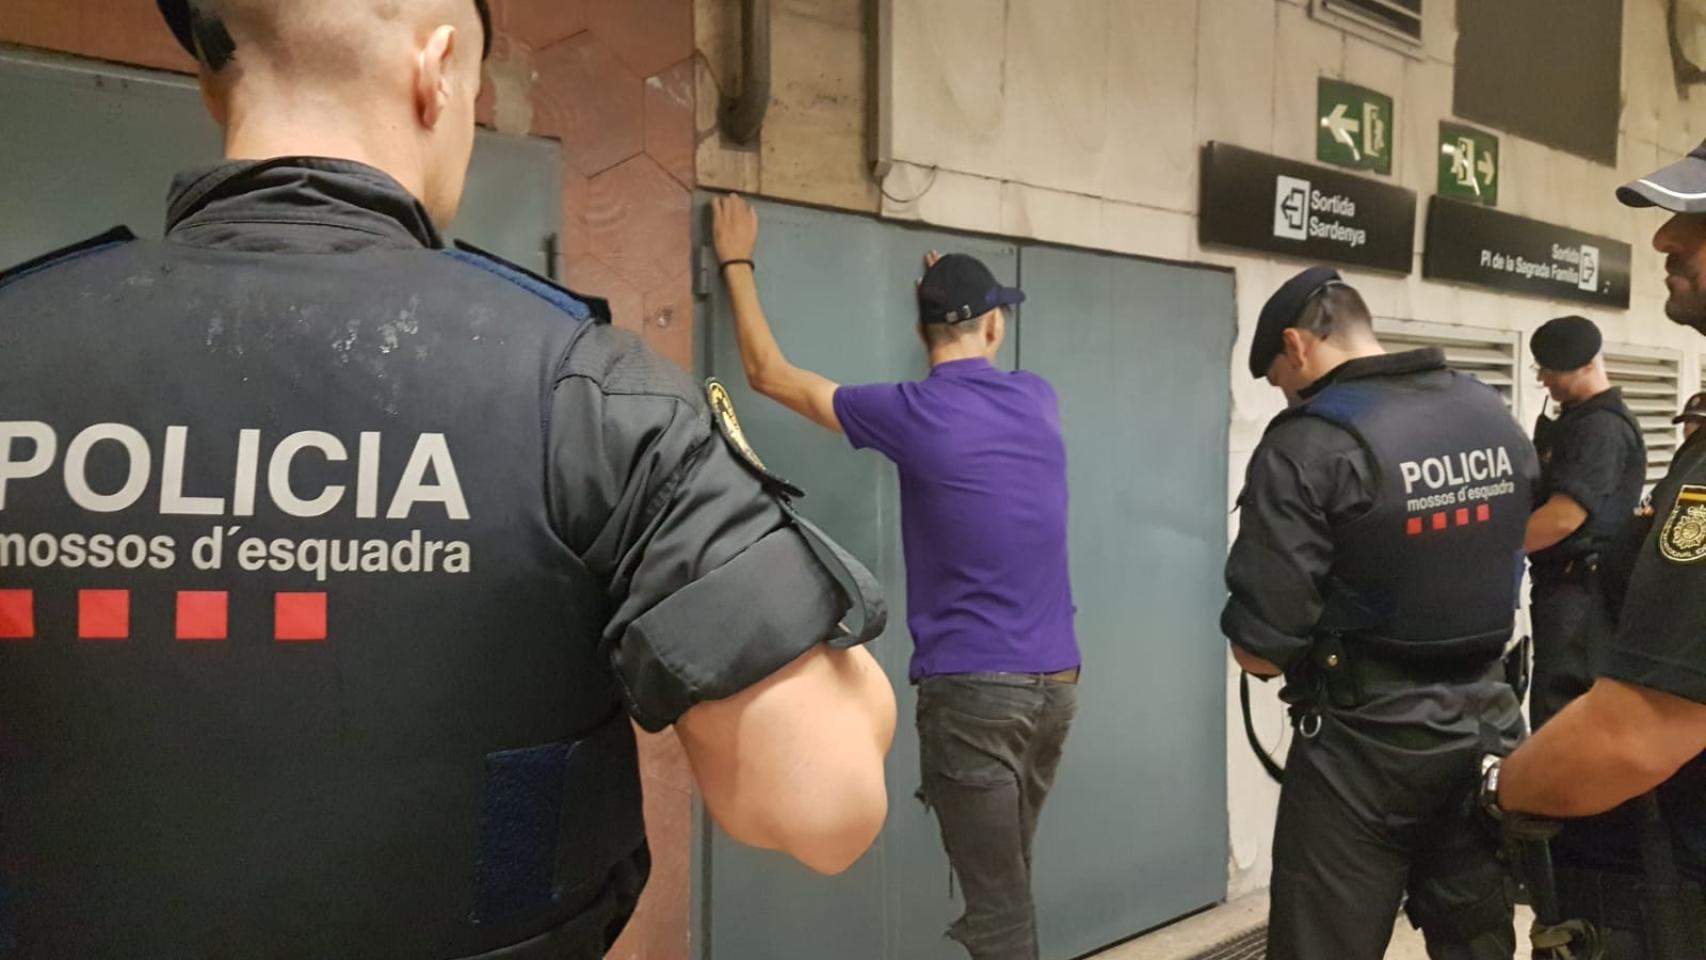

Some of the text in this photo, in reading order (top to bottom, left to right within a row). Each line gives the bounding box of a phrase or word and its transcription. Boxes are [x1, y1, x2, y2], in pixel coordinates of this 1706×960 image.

[1311, 190, 1355, 217] Sortida
[1309, 216, 1366, 247] Sardenya
[1492, 252, 1504, 270] de
[1505, 254, 1514, 272] la
[1515, 256, 1550, 278] Sagrada
[1552, 243, 1580, 263] Sortida
[0, 420, 471, 520] POLICIA
[1400, 446, 1513, 494] POLICIA
[1407, 492, 1455, 512] mossos
